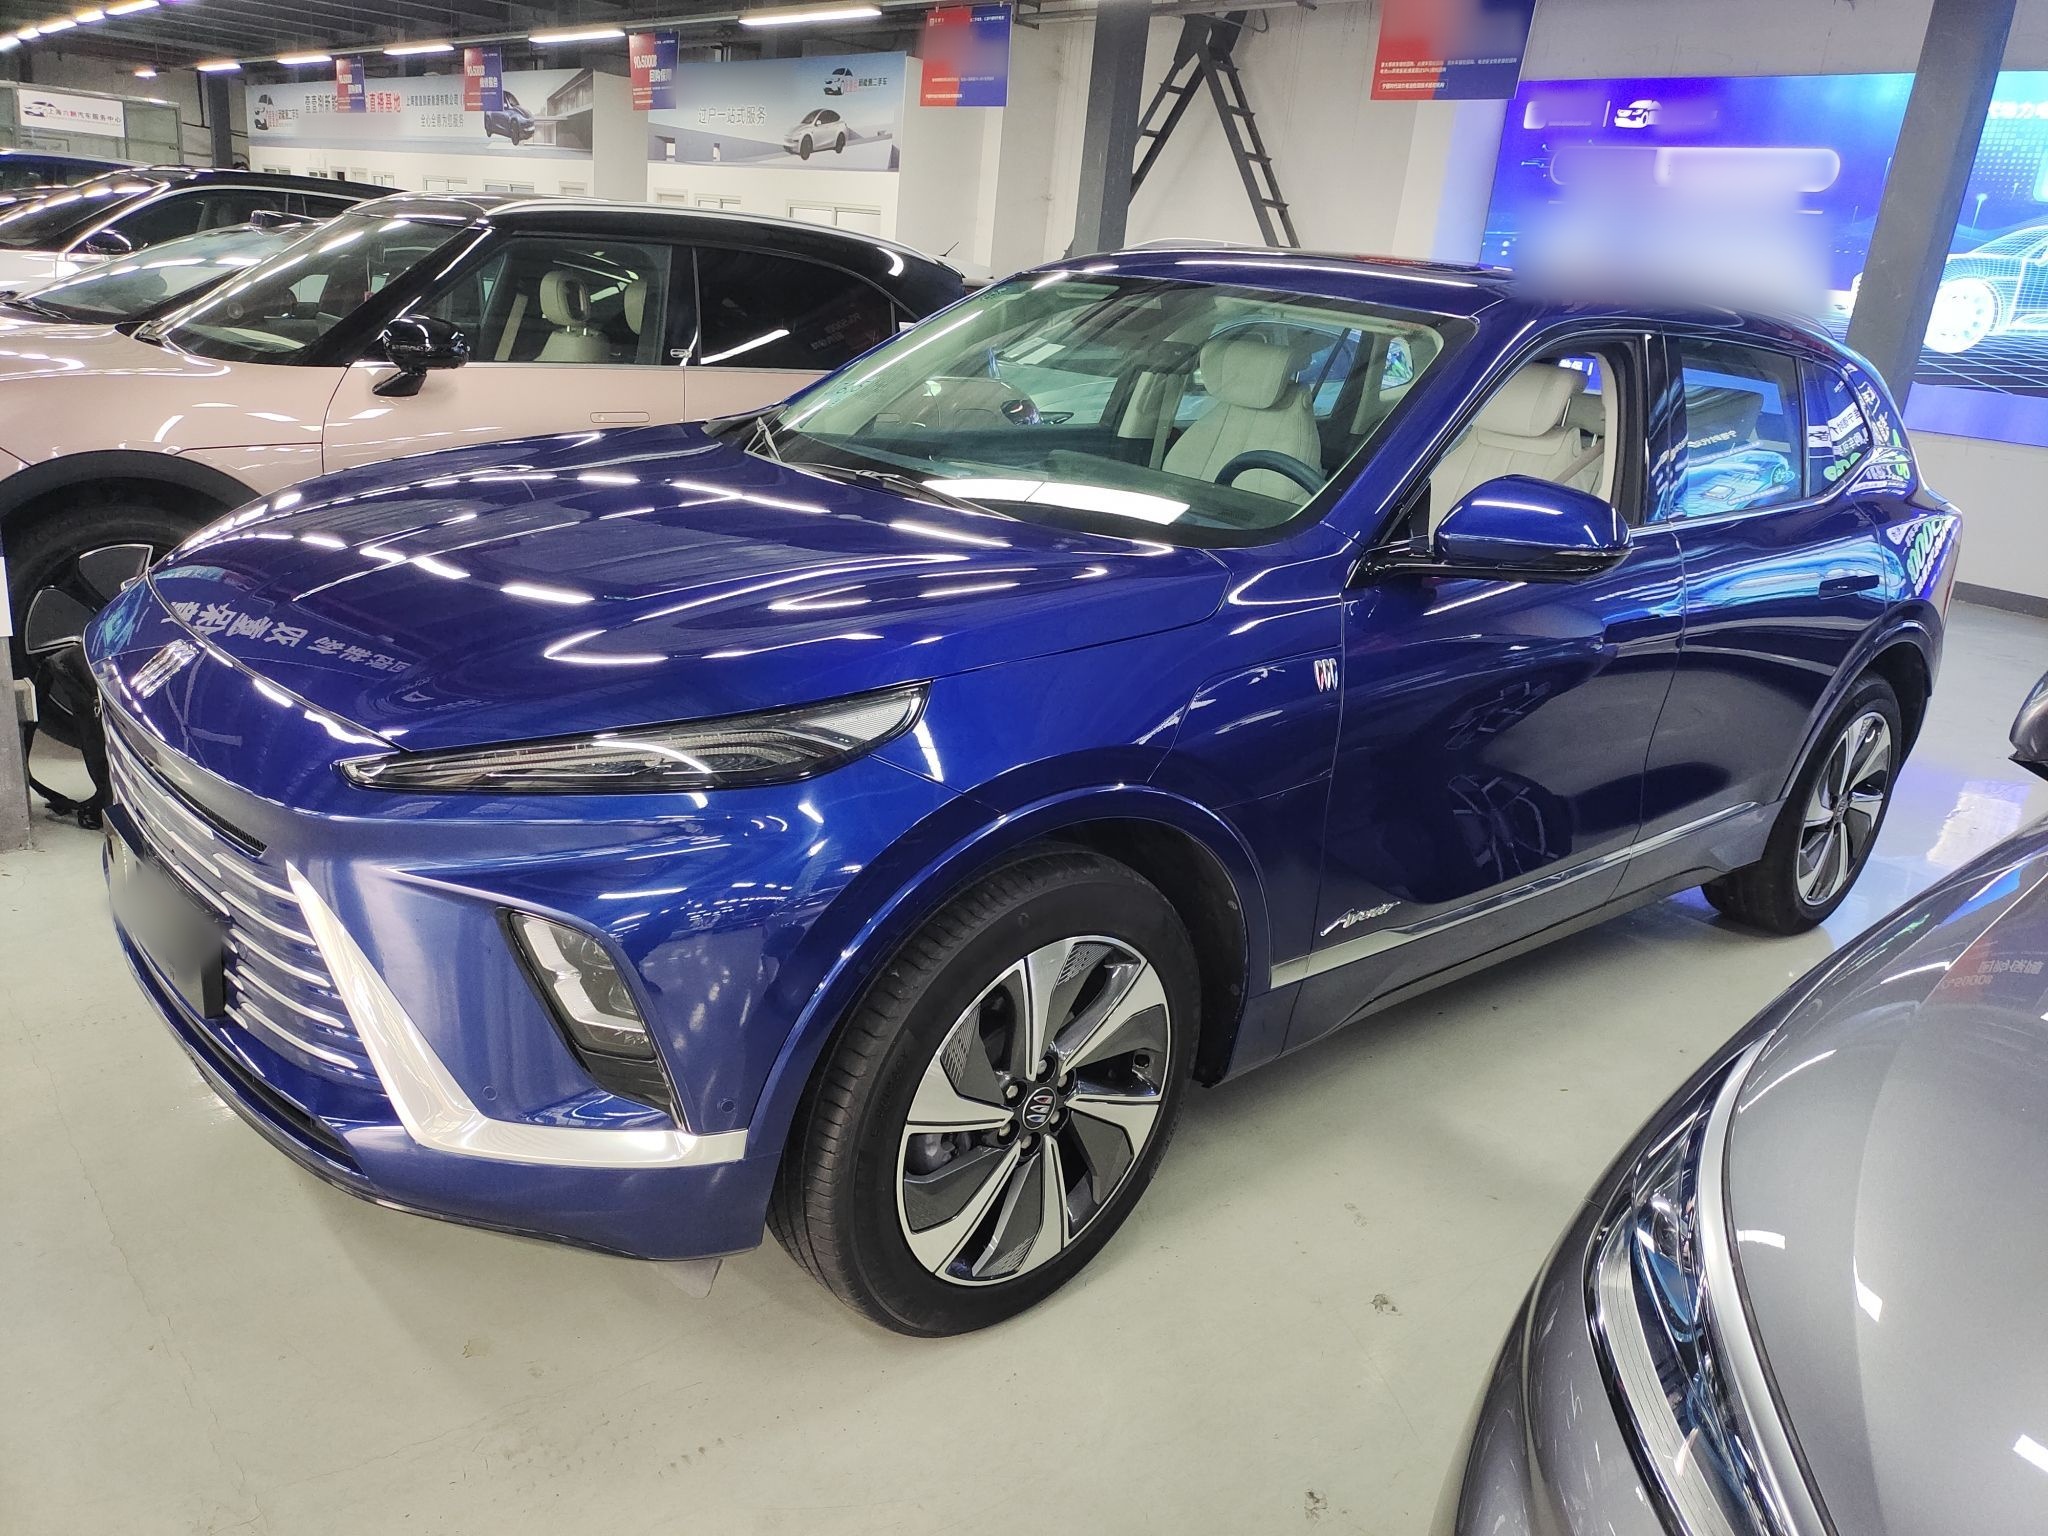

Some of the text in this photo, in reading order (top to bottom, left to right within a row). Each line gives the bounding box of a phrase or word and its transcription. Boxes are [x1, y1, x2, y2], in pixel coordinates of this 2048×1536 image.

[368, 92, 402, 113] 直播基地
[420, 113, 464, 128] 全心全意为您服务
[698, 106, 767, 124] 过户一站式服务
